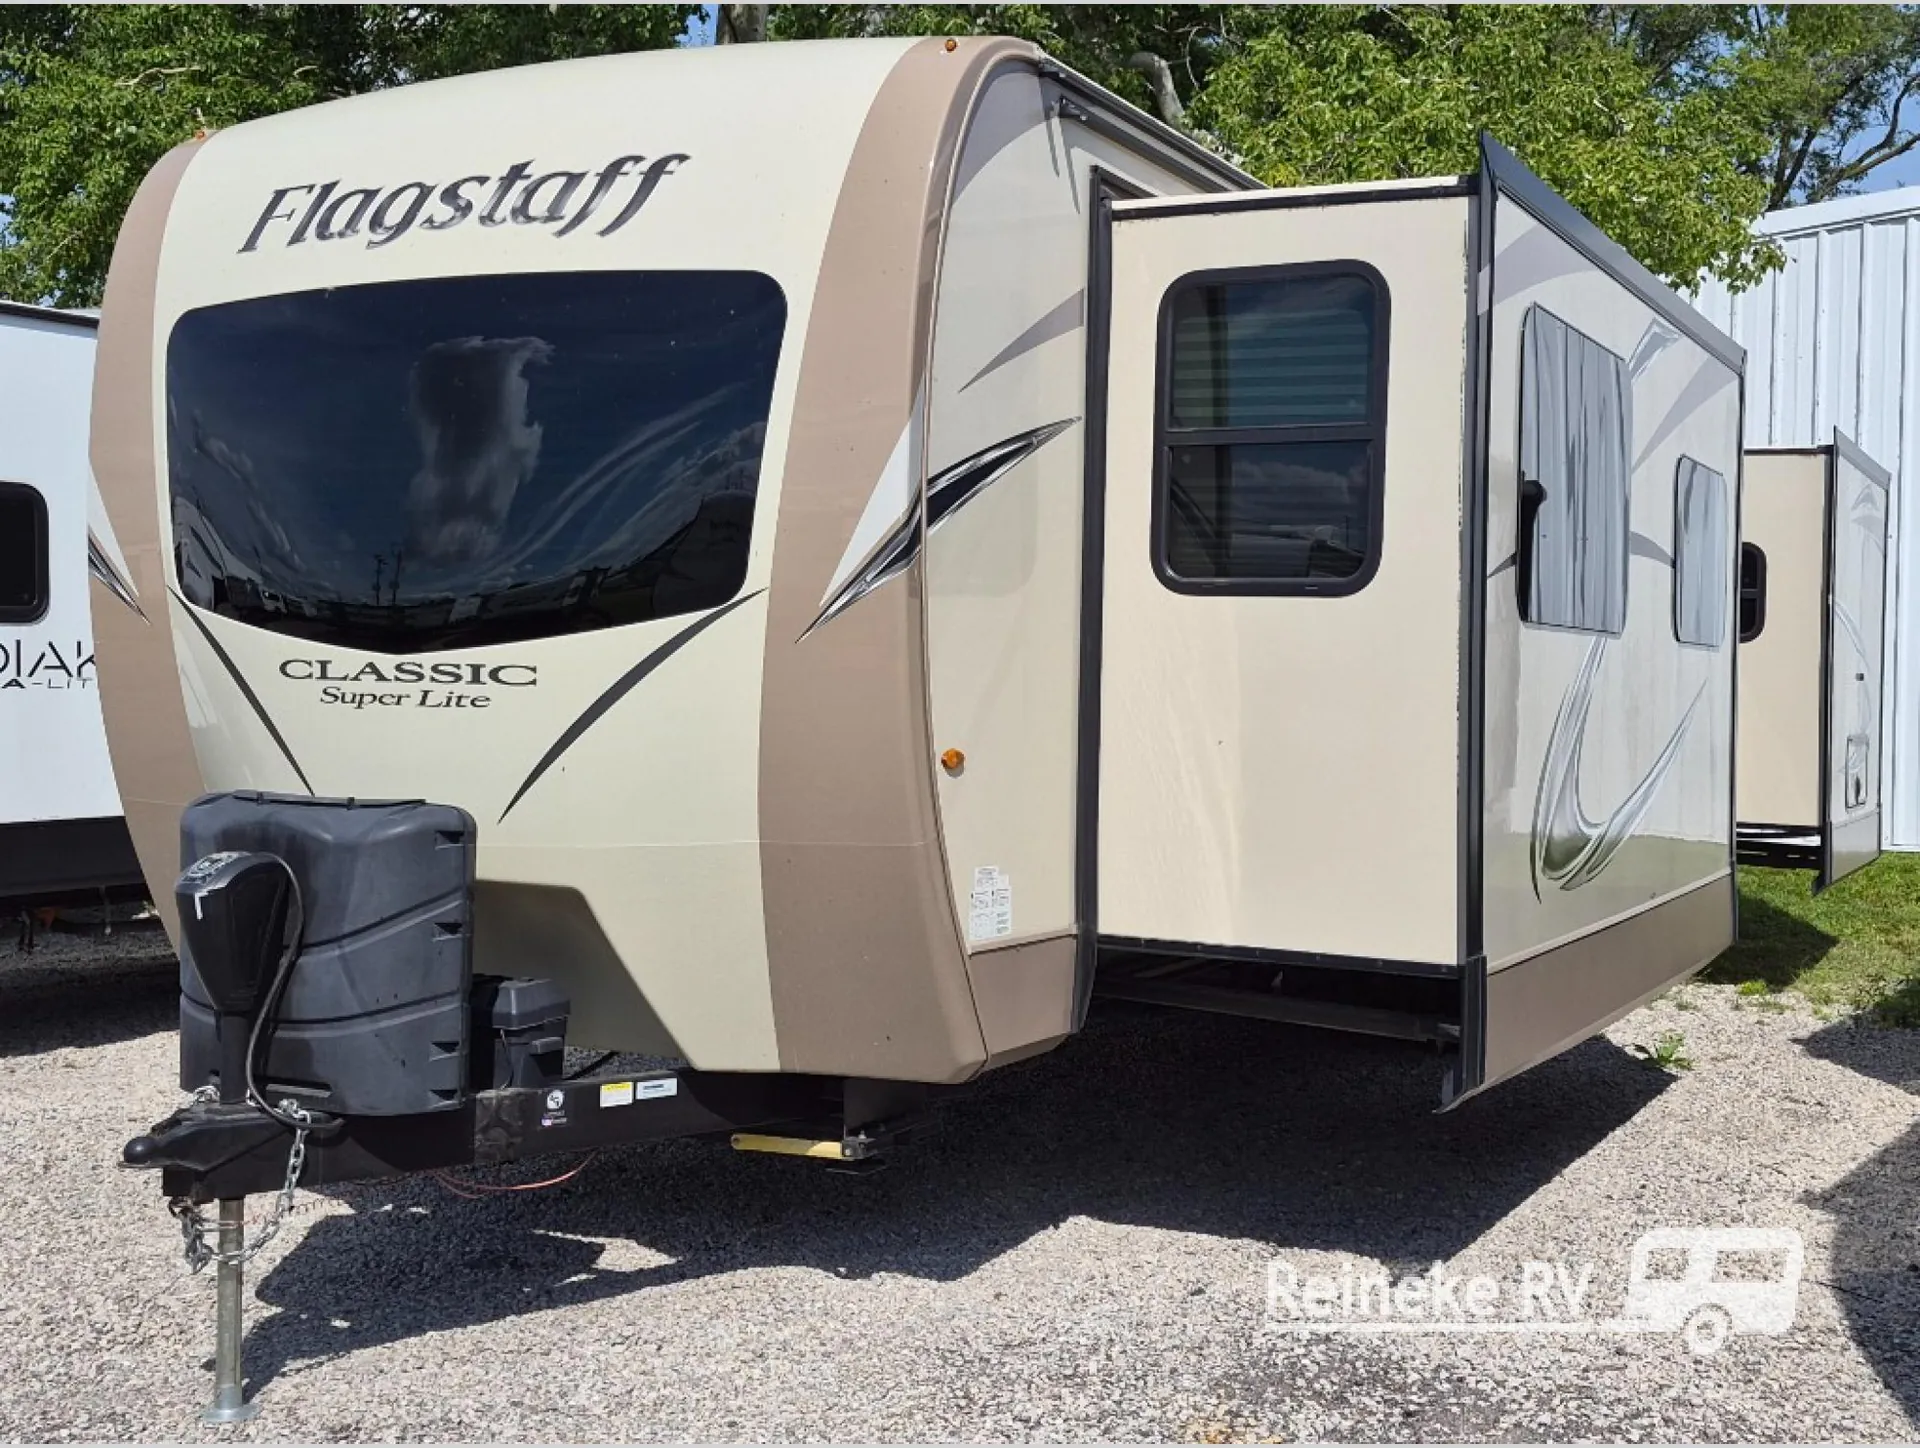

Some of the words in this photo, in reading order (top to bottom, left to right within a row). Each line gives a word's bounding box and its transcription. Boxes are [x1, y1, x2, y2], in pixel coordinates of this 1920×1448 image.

[236, 153, 692, 255] Flagstaff
[1, 677, 93, 690] A-LIT
[279, 658, 537, 687] CLASSIC
[320, 686, 411, 710] Super
[417, 689, 492, 709] Lite
